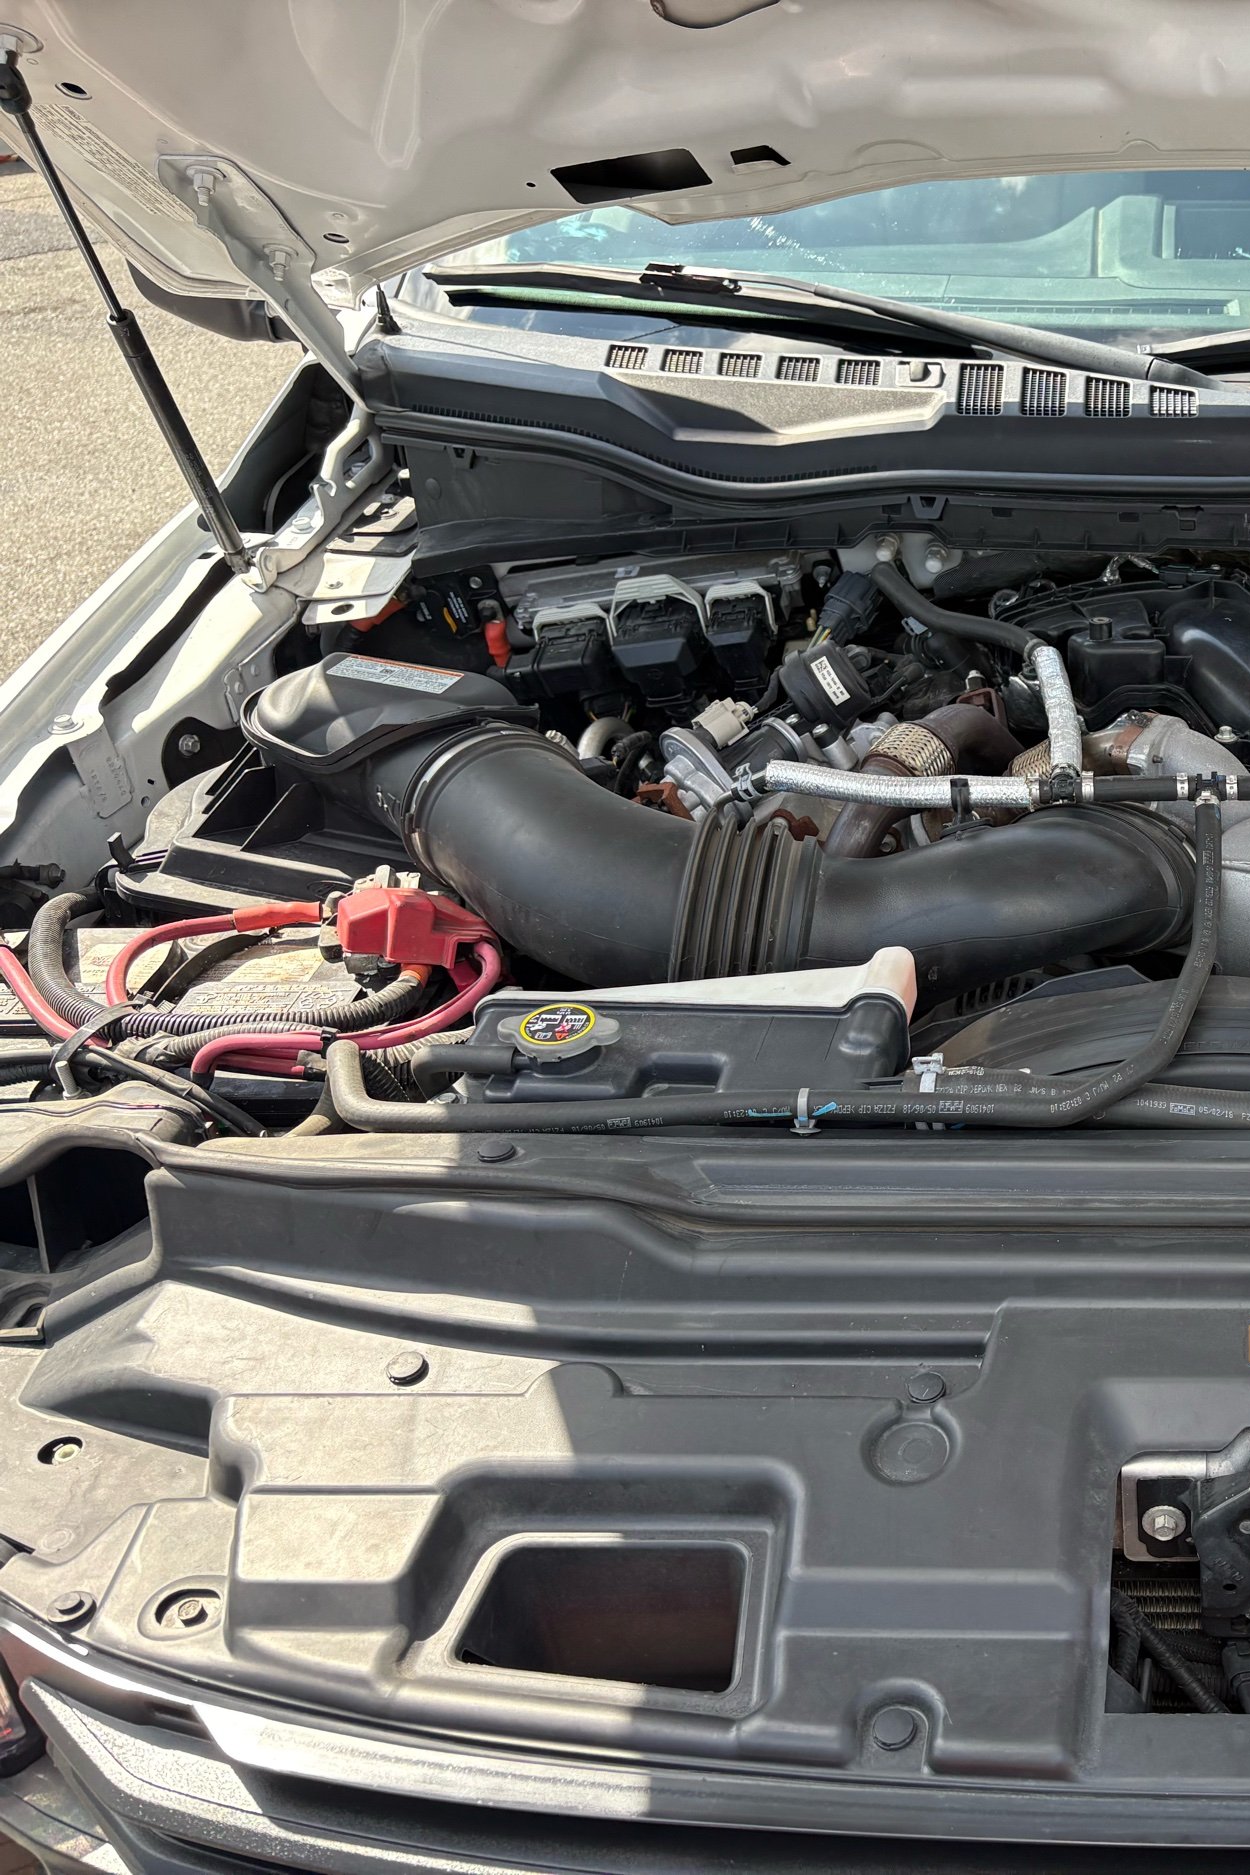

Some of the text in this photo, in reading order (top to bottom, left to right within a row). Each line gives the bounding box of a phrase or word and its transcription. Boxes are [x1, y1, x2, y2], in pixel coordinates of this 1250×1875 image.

[859, 1104, 871, 1113] CIP
[874, 1104, 896, 1113] FZTZA
[903, 1104, 936, 1113] 05/06/18
[966, 1104, 994, 1113] 1041909
[1137, 1100, 1166, 1109] 1041939
[634, 1117, 664, 1126] 1041909
